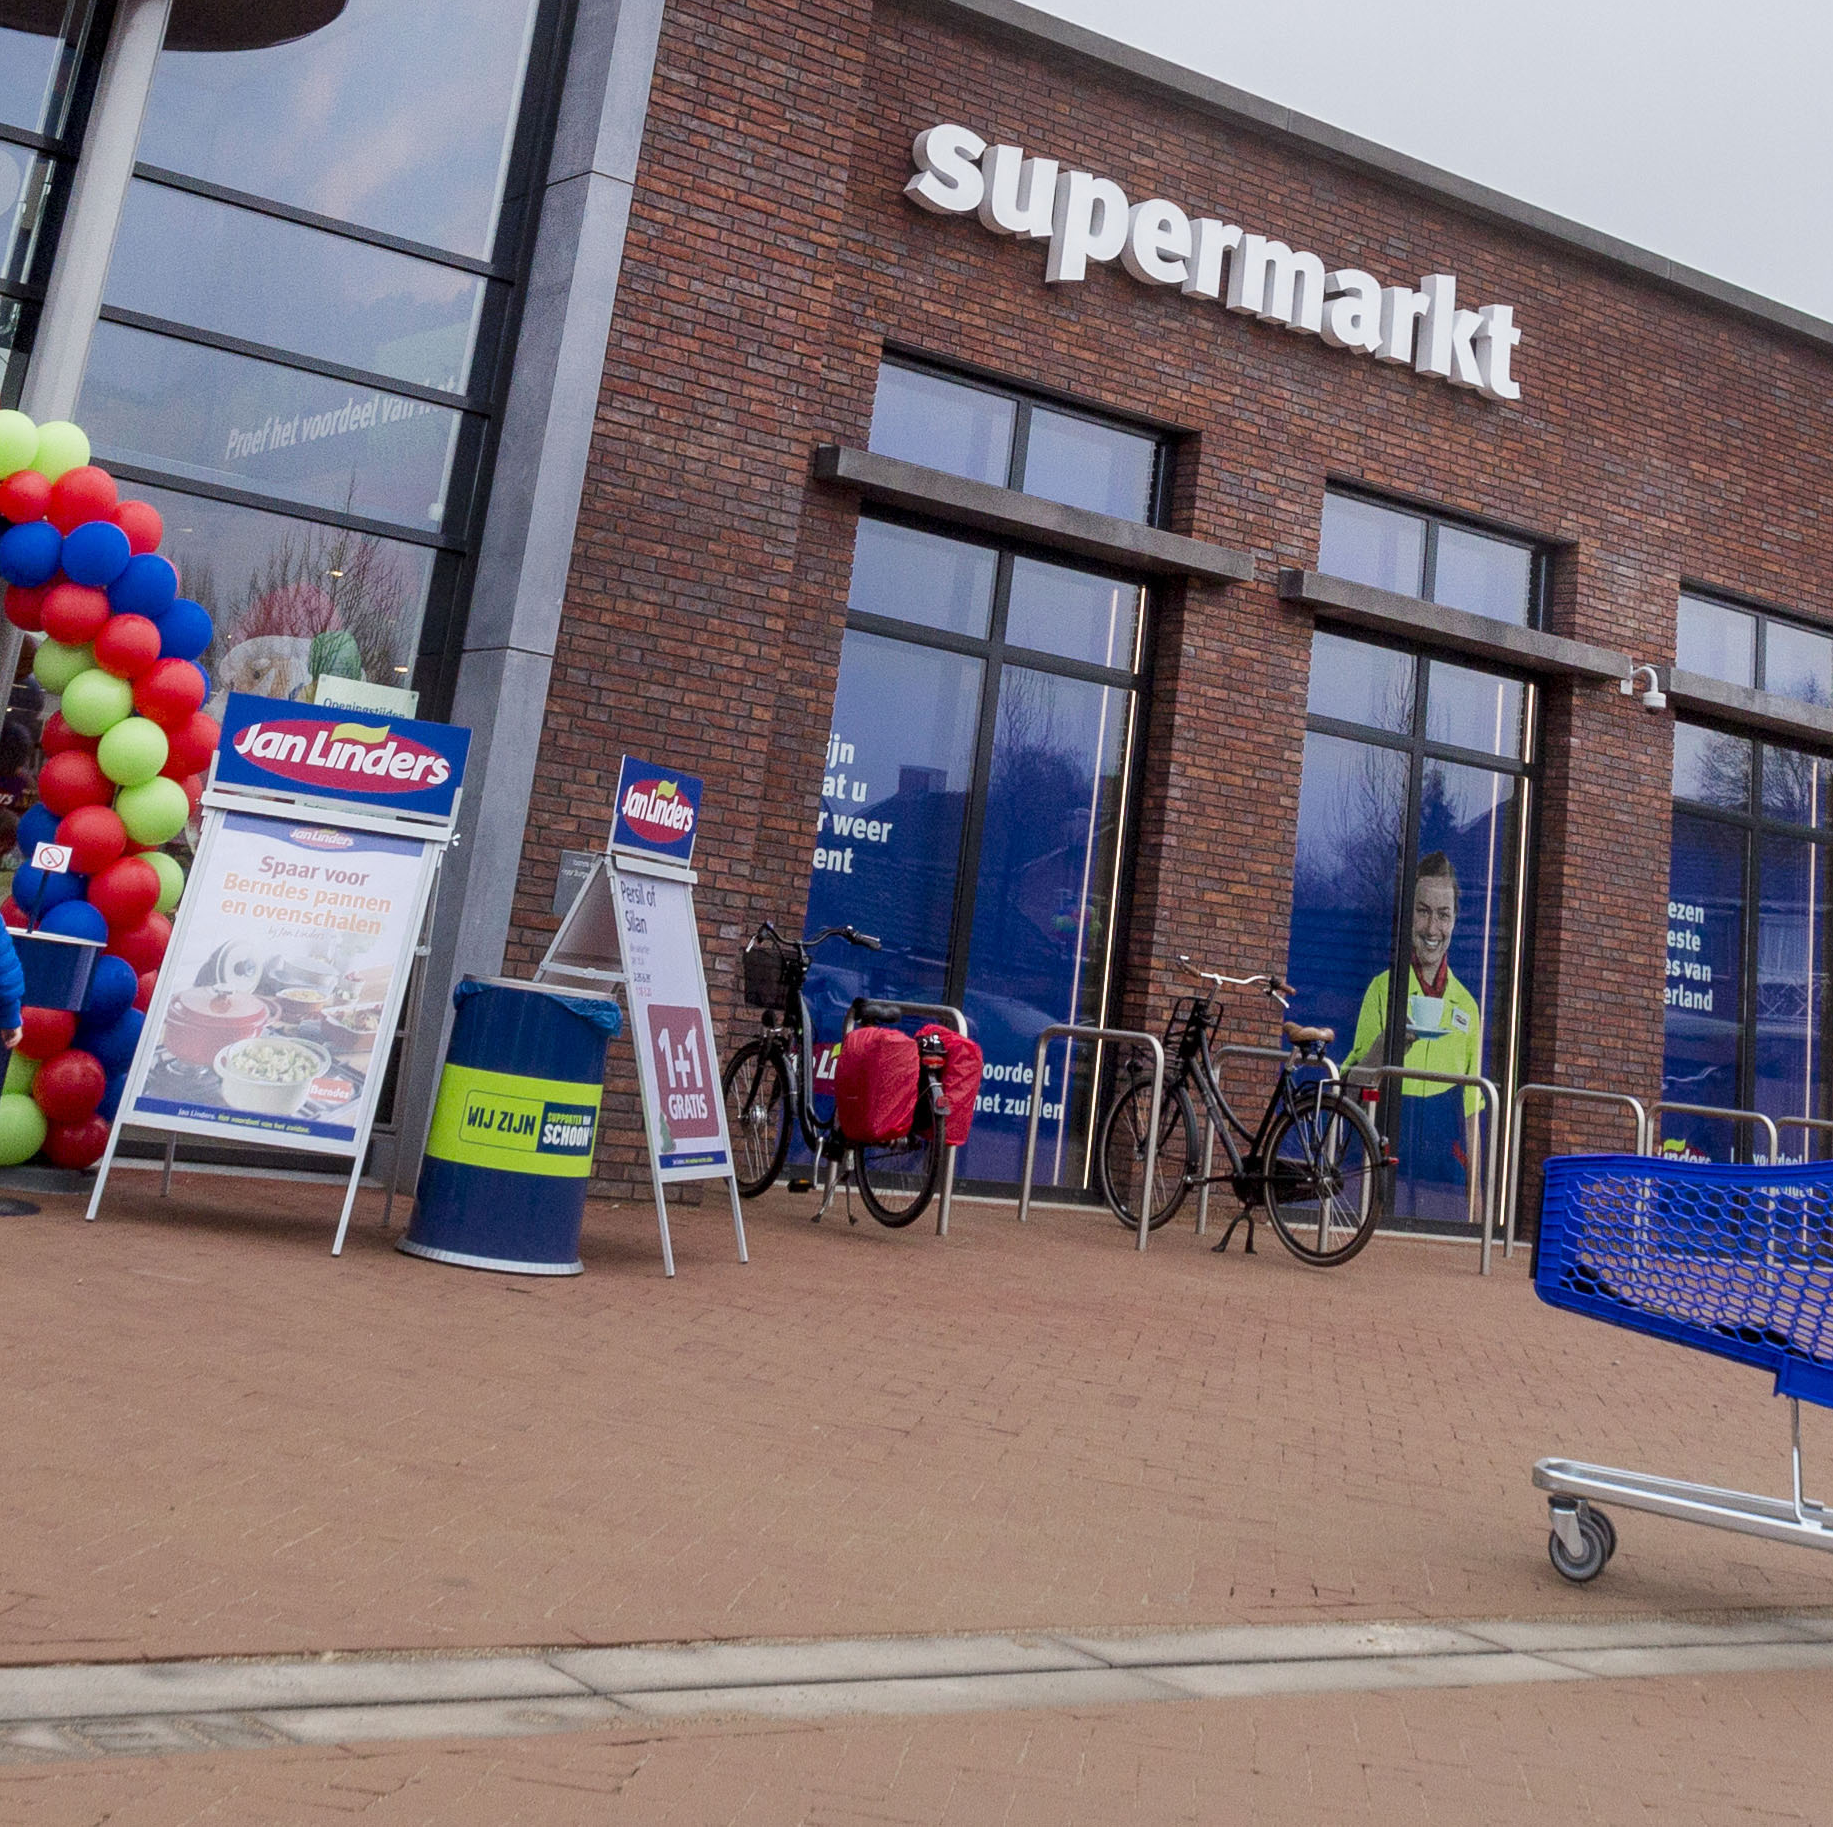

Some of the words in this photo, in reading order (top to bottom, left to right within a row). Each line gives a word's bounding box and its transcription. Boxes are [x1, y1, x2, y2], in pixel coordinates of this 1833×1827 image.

[902, 123, 1522, 401] supermarkt
[225, 419, 269, 461] Proef
[267, 414, 298, 450] het
[301, 394, 379, 442] voordeel
[234, 723, 307, 763] Jan
[306, 730, 450, 785] Linders
[822, 774, 846, 799] at
[852, 782, 867, 802] u
[622, 785, 648, 819] Jan
[645, 789, 694, 832] Linders
[290, 828, 311, 840] Jan
[310, 830, 354, 847] Linders
[832, 814, 893, 843] weer
[258, 855, 320, 879] Spaar
[325, 868, 370, 886] voor
[813, 847, 854, 873] ent
[223, 872, 309, 901] Berndes
[313, 889, 392, 913] pannen
[621, 881, 645, 905] Persil
[647, 885, 656, 907] of
[221, 898, 247, 915] en
[252, 901, 382, 935] ovenschalen
[625, 910, 647, 934] Silan
[1668, 901, 1704, 924] ezen
[1667, 929, 1701, 952] este
[1684, 961, 1712, 982] van
[1663, 983, 1713, 1012] erland
[658, 1027, 703, 1088] 1+1
[467, 1106, 495, 1129] WIJ
[497, 1111, 536, 1136] ZIJN
[669, 1094, 707, 1119] GRATIS
